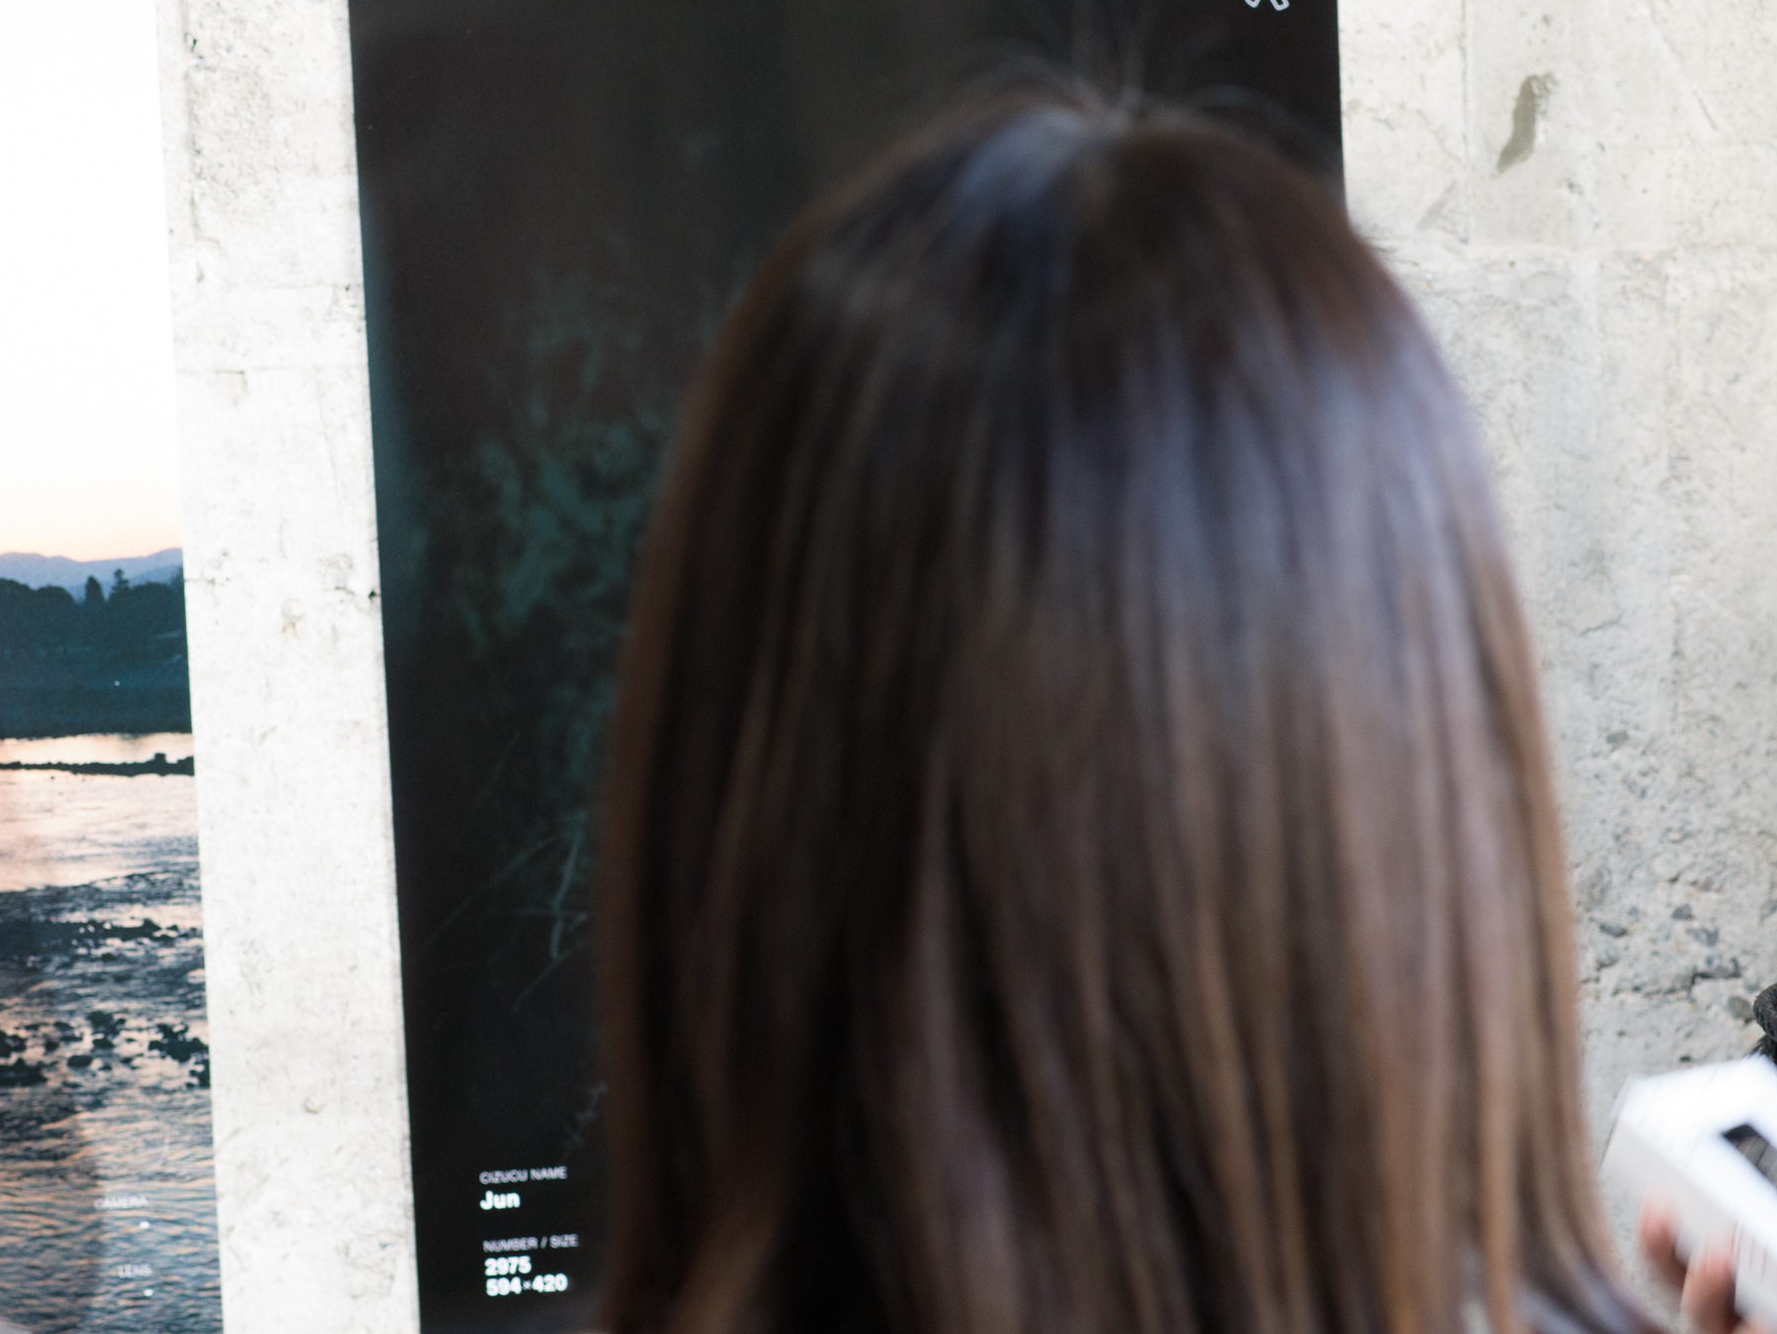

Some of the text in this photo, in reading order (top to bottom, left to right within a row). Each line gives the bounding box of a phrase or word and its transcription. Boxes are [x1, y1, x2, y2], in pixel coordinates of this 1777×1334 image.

[530, 1166, 567, 1180] NAME
[94, 1195, 149, 1210] CAMERA
[479, 1190, 520, 1210] Jun
[483, 1236, 538, 1252] NUMBER
[549, 1233, 579, 1248] SIZE
[118, 1264, 152, 1278] LENS
[484, 1255, 532, 1276] 2975
